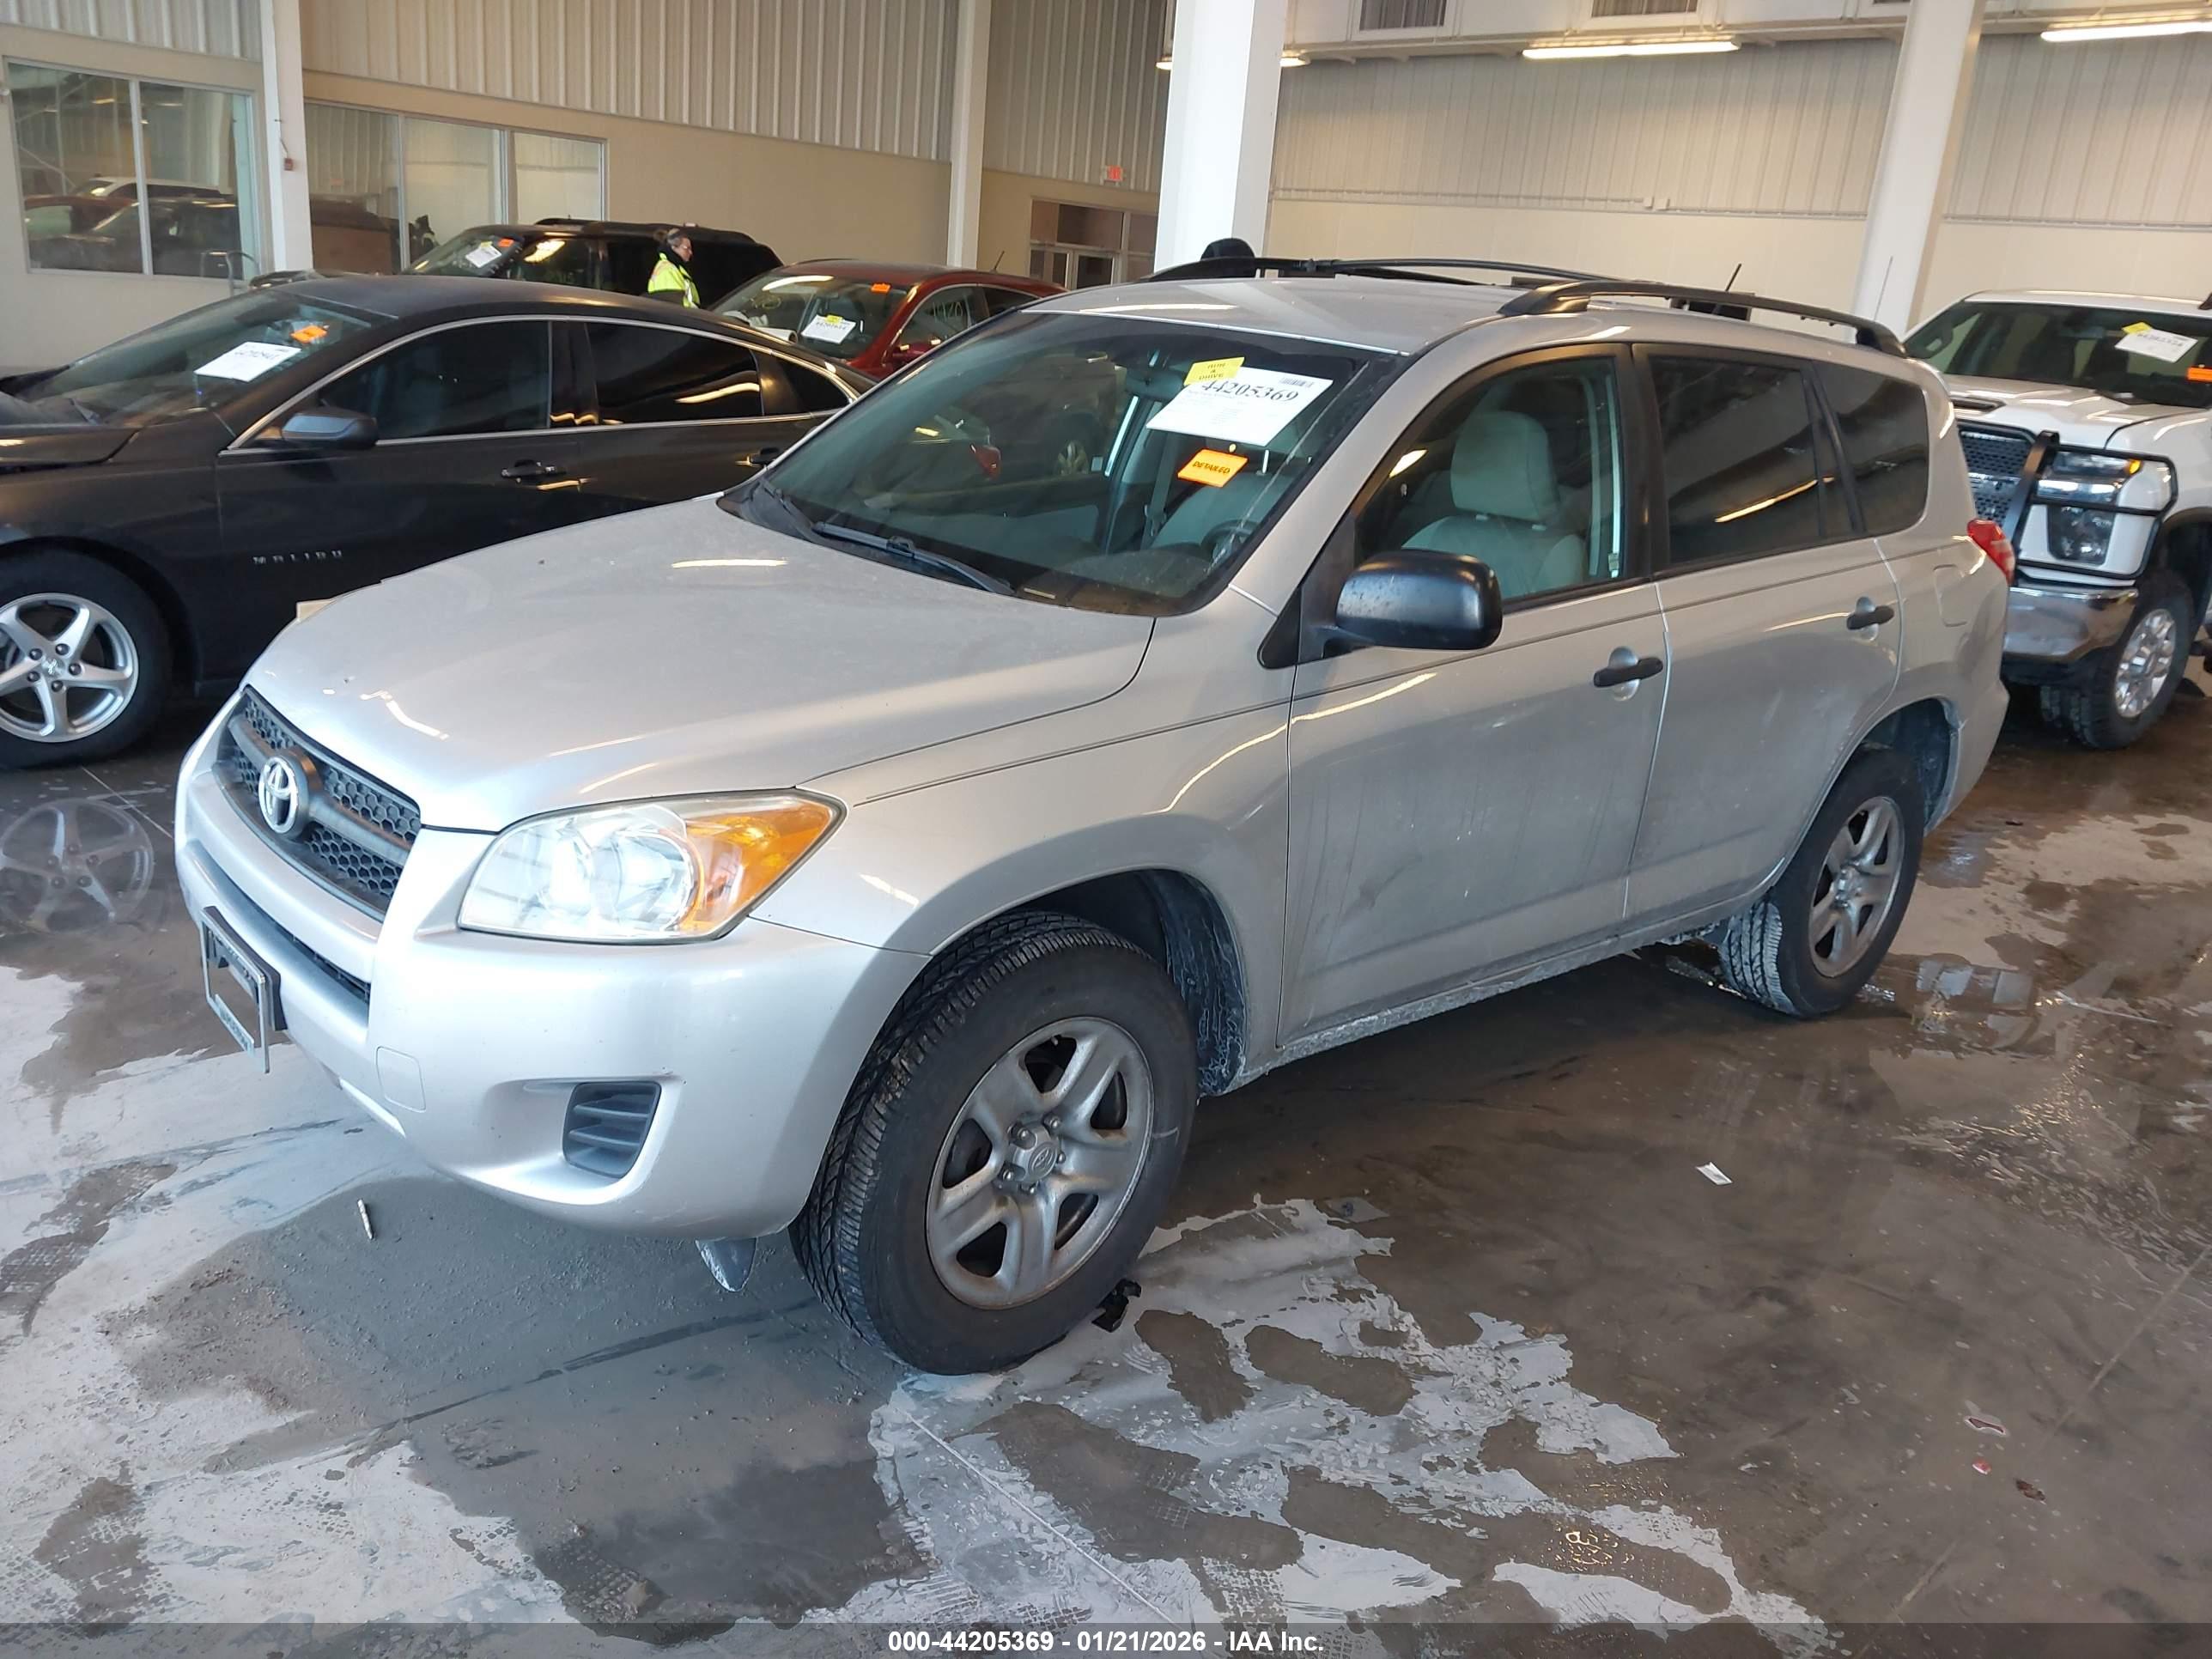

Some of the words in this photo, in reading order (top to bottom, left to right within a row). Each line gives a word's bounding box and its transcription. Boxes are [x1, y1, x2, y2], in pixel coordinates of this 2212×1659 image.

[1201, 380, 1299, 402] 44205369
[1193, 460, 1231, 473] DETAILED
[252, 550, 343, 564] MALIBU
